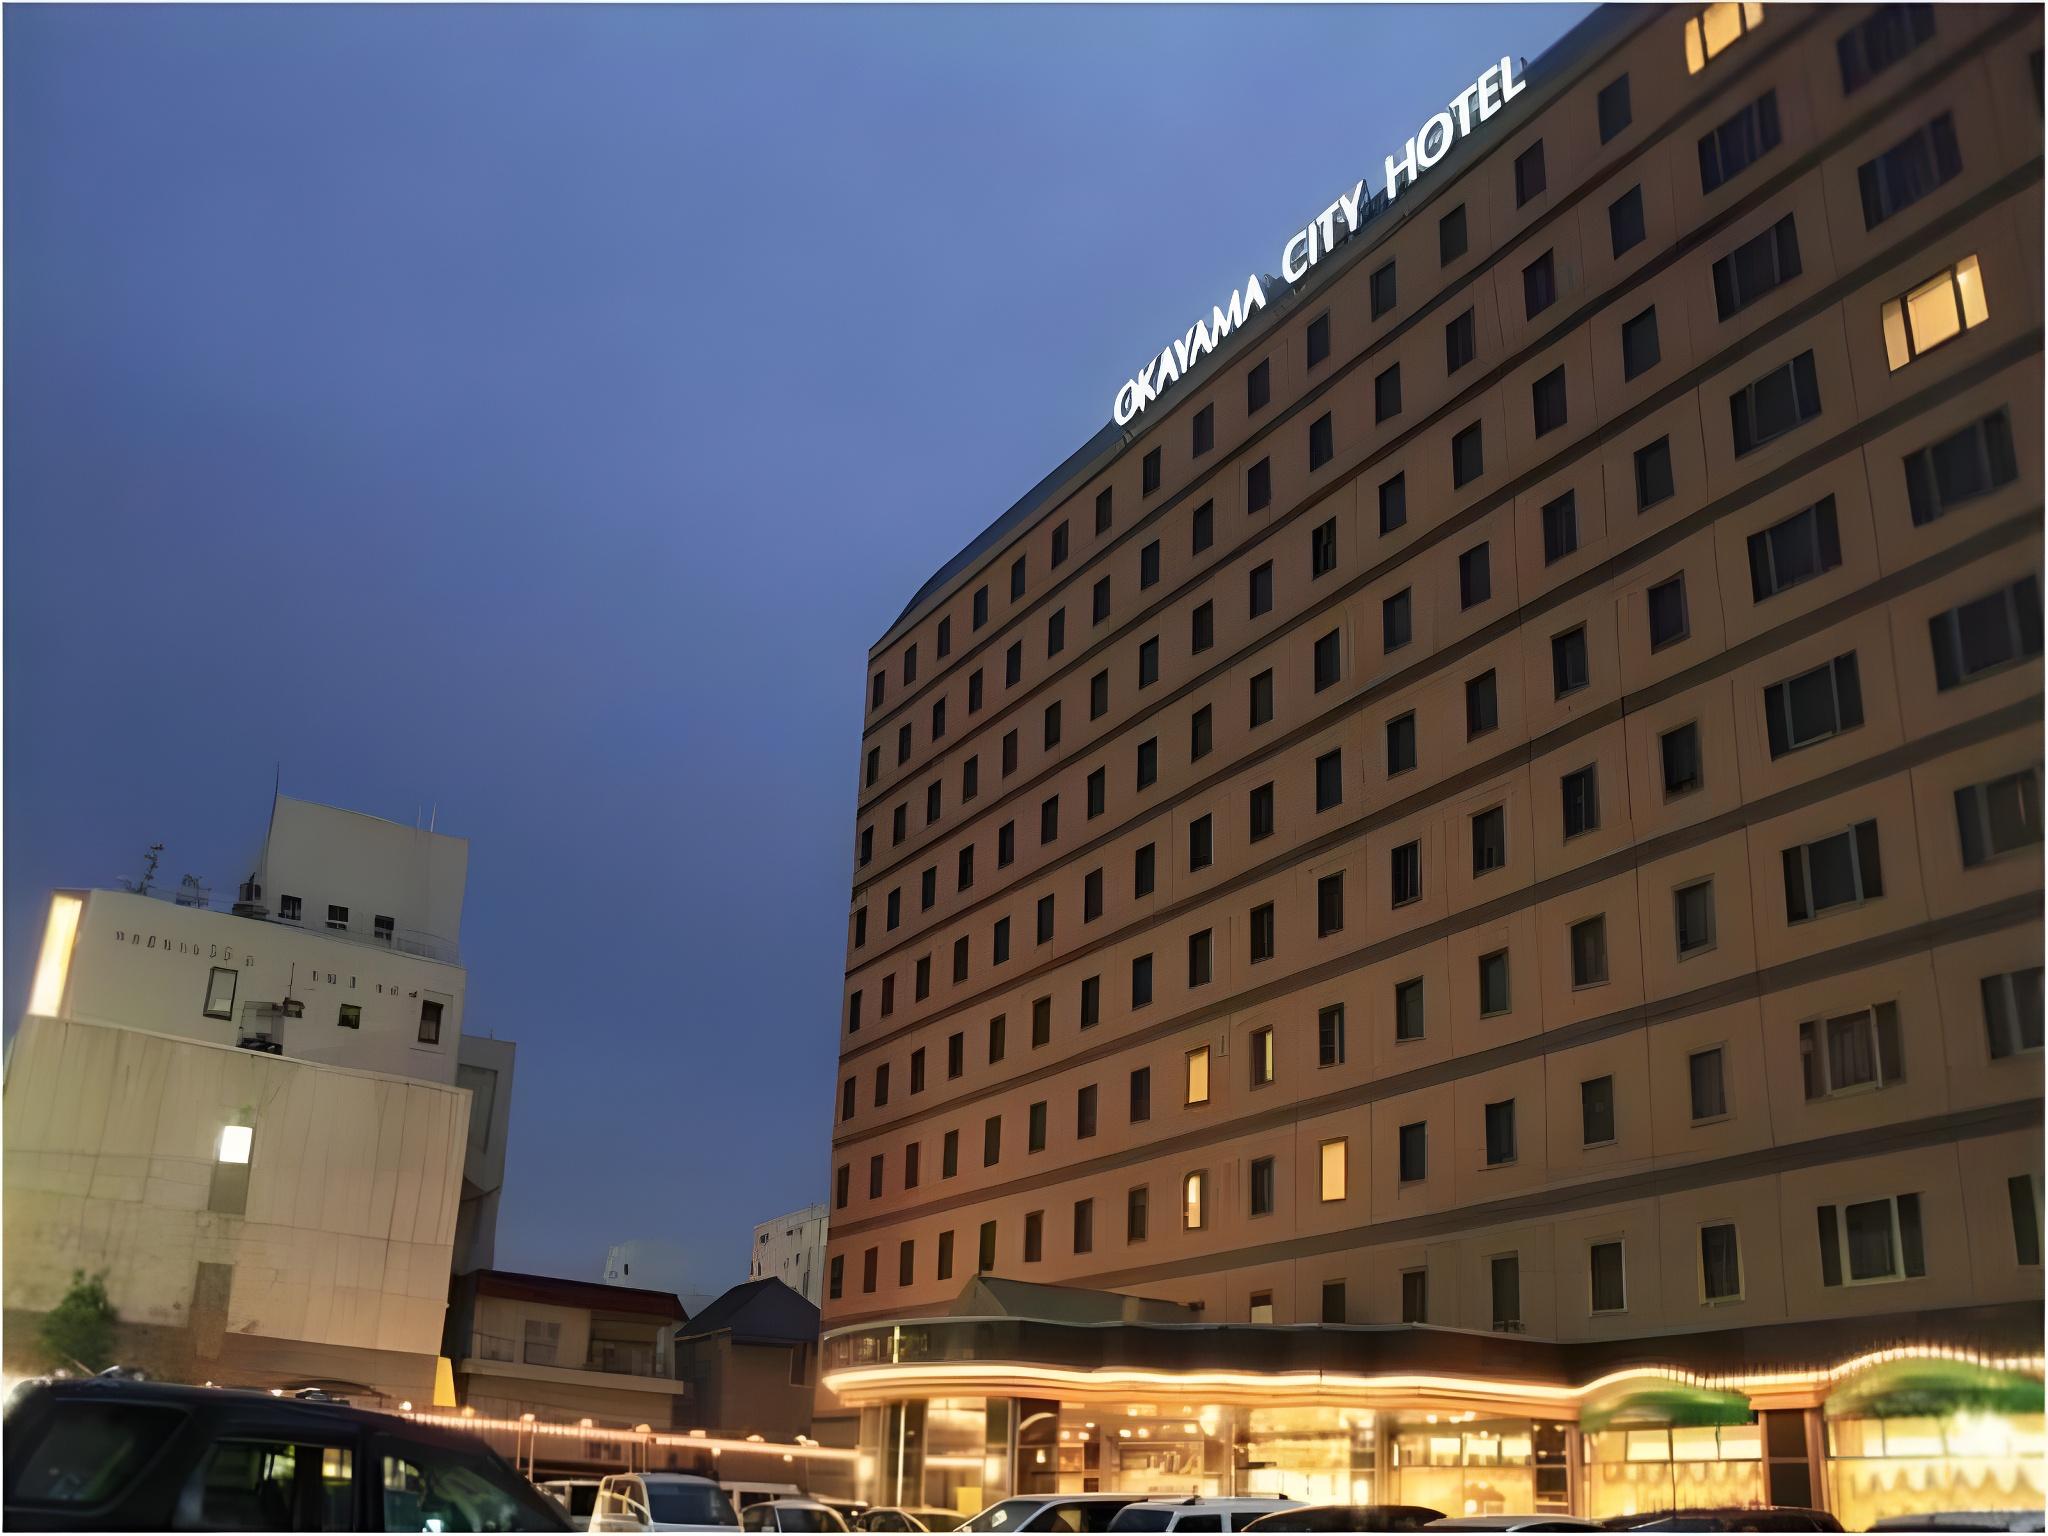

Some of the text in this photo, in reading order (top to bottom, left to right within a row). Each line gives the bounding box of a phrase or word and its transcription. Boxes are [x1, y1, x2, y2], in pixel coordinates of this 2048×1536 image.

[1113, 56, 1527, 426] OKAYAMA CITY HOTEL
